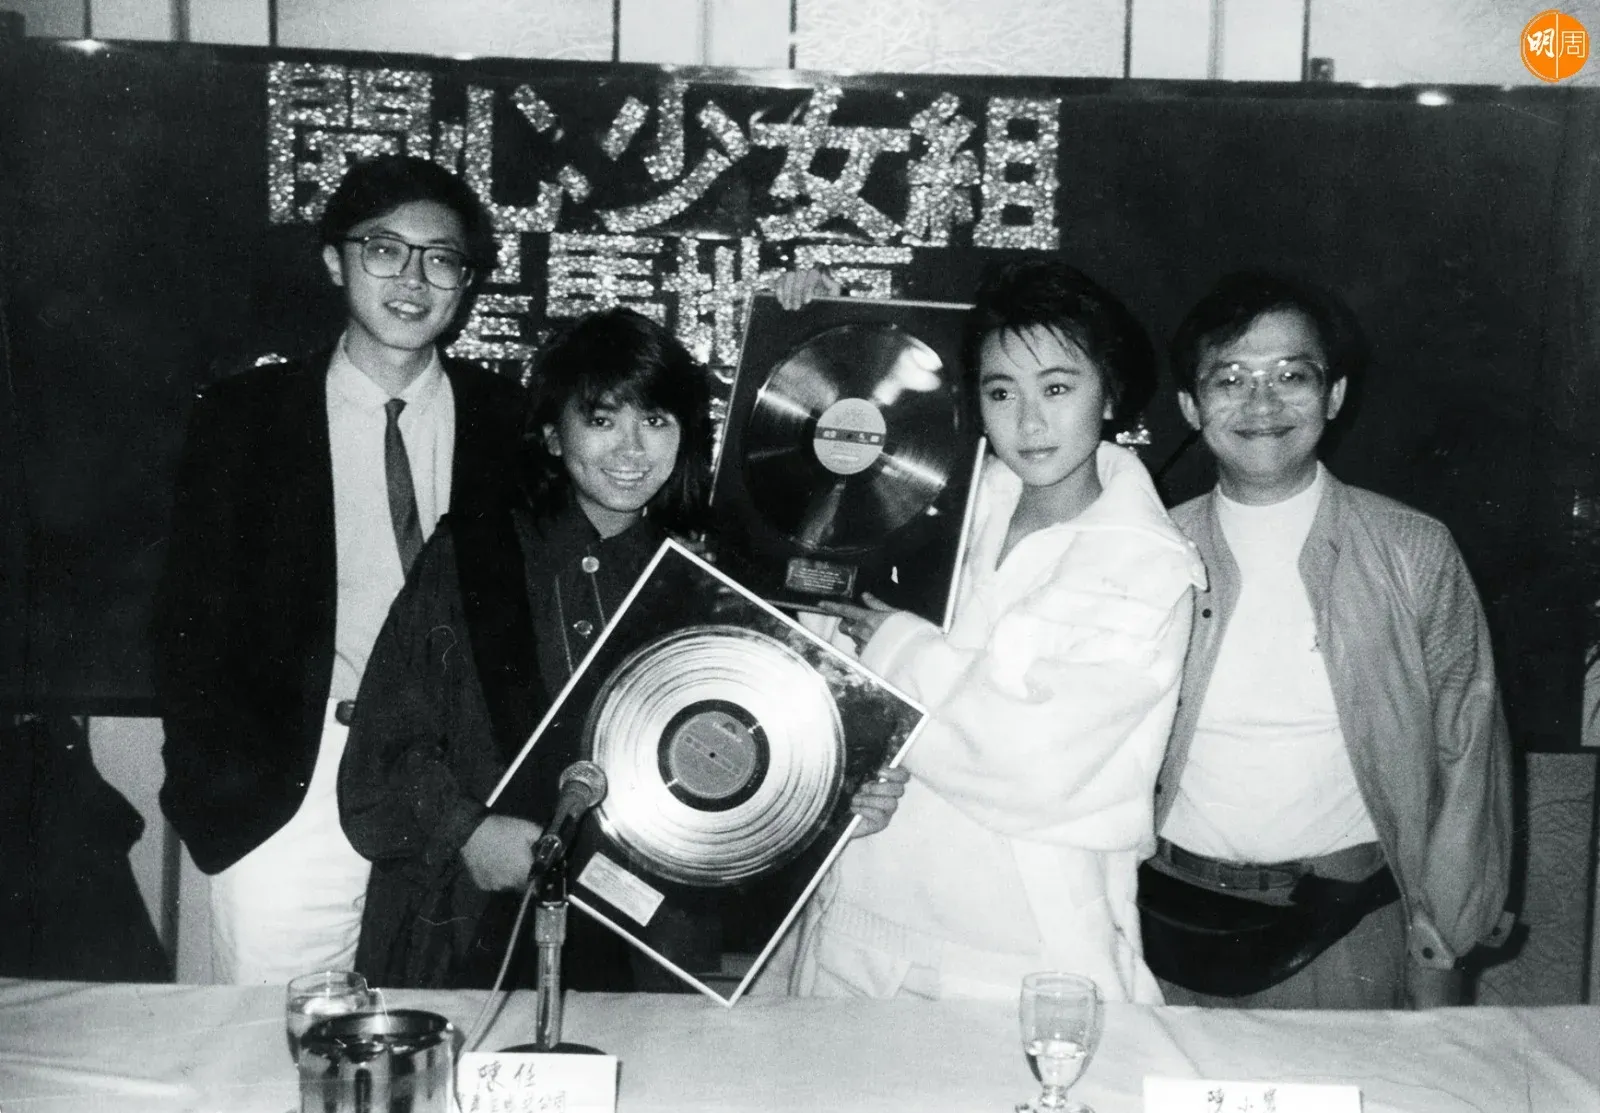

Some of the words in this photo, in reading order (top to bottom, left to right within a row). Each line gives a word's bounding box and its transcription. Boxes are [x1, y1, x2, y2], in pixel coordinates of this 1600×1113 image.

[267, 62, 1062, 252] 開心少女組
